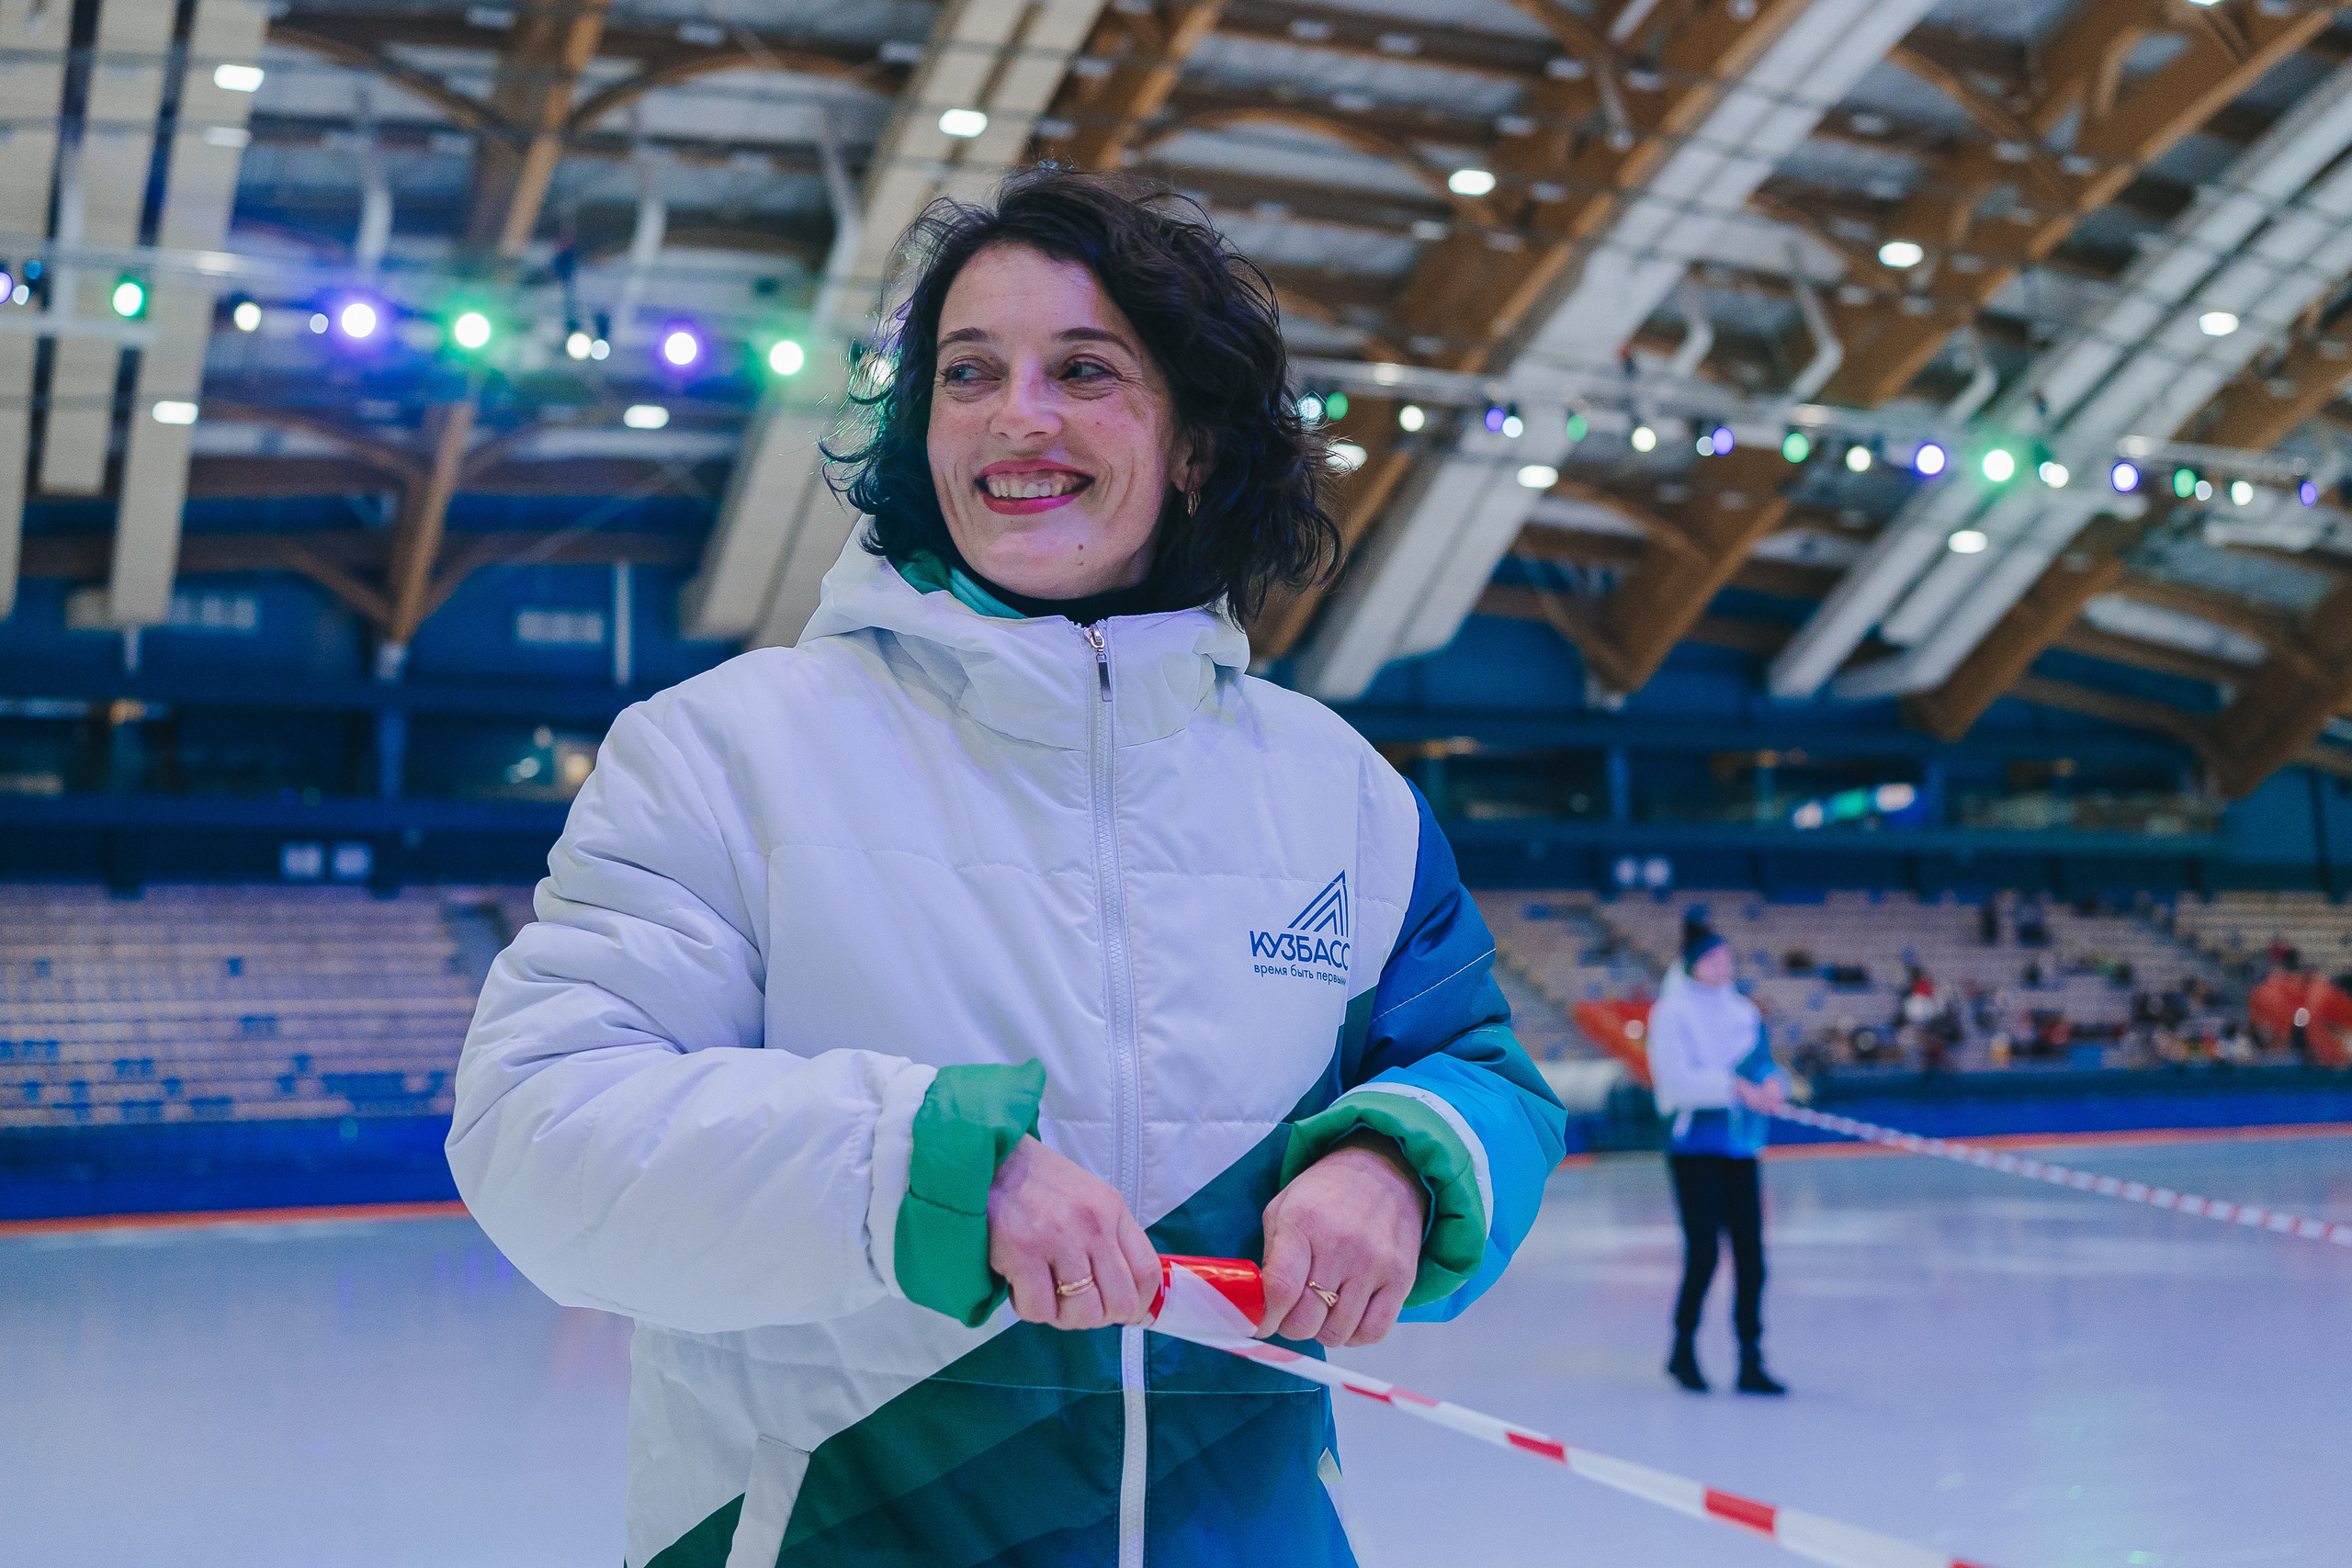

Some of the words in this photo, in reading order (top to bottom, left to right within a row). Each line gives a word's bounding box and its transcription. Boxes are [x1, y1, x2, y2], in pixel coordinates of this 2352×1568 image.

[1250, 931, 1351, 971] КУЗБАСС
[1254, 964, 1288, 977] время
[1290, 964, 1314, 979] быть
